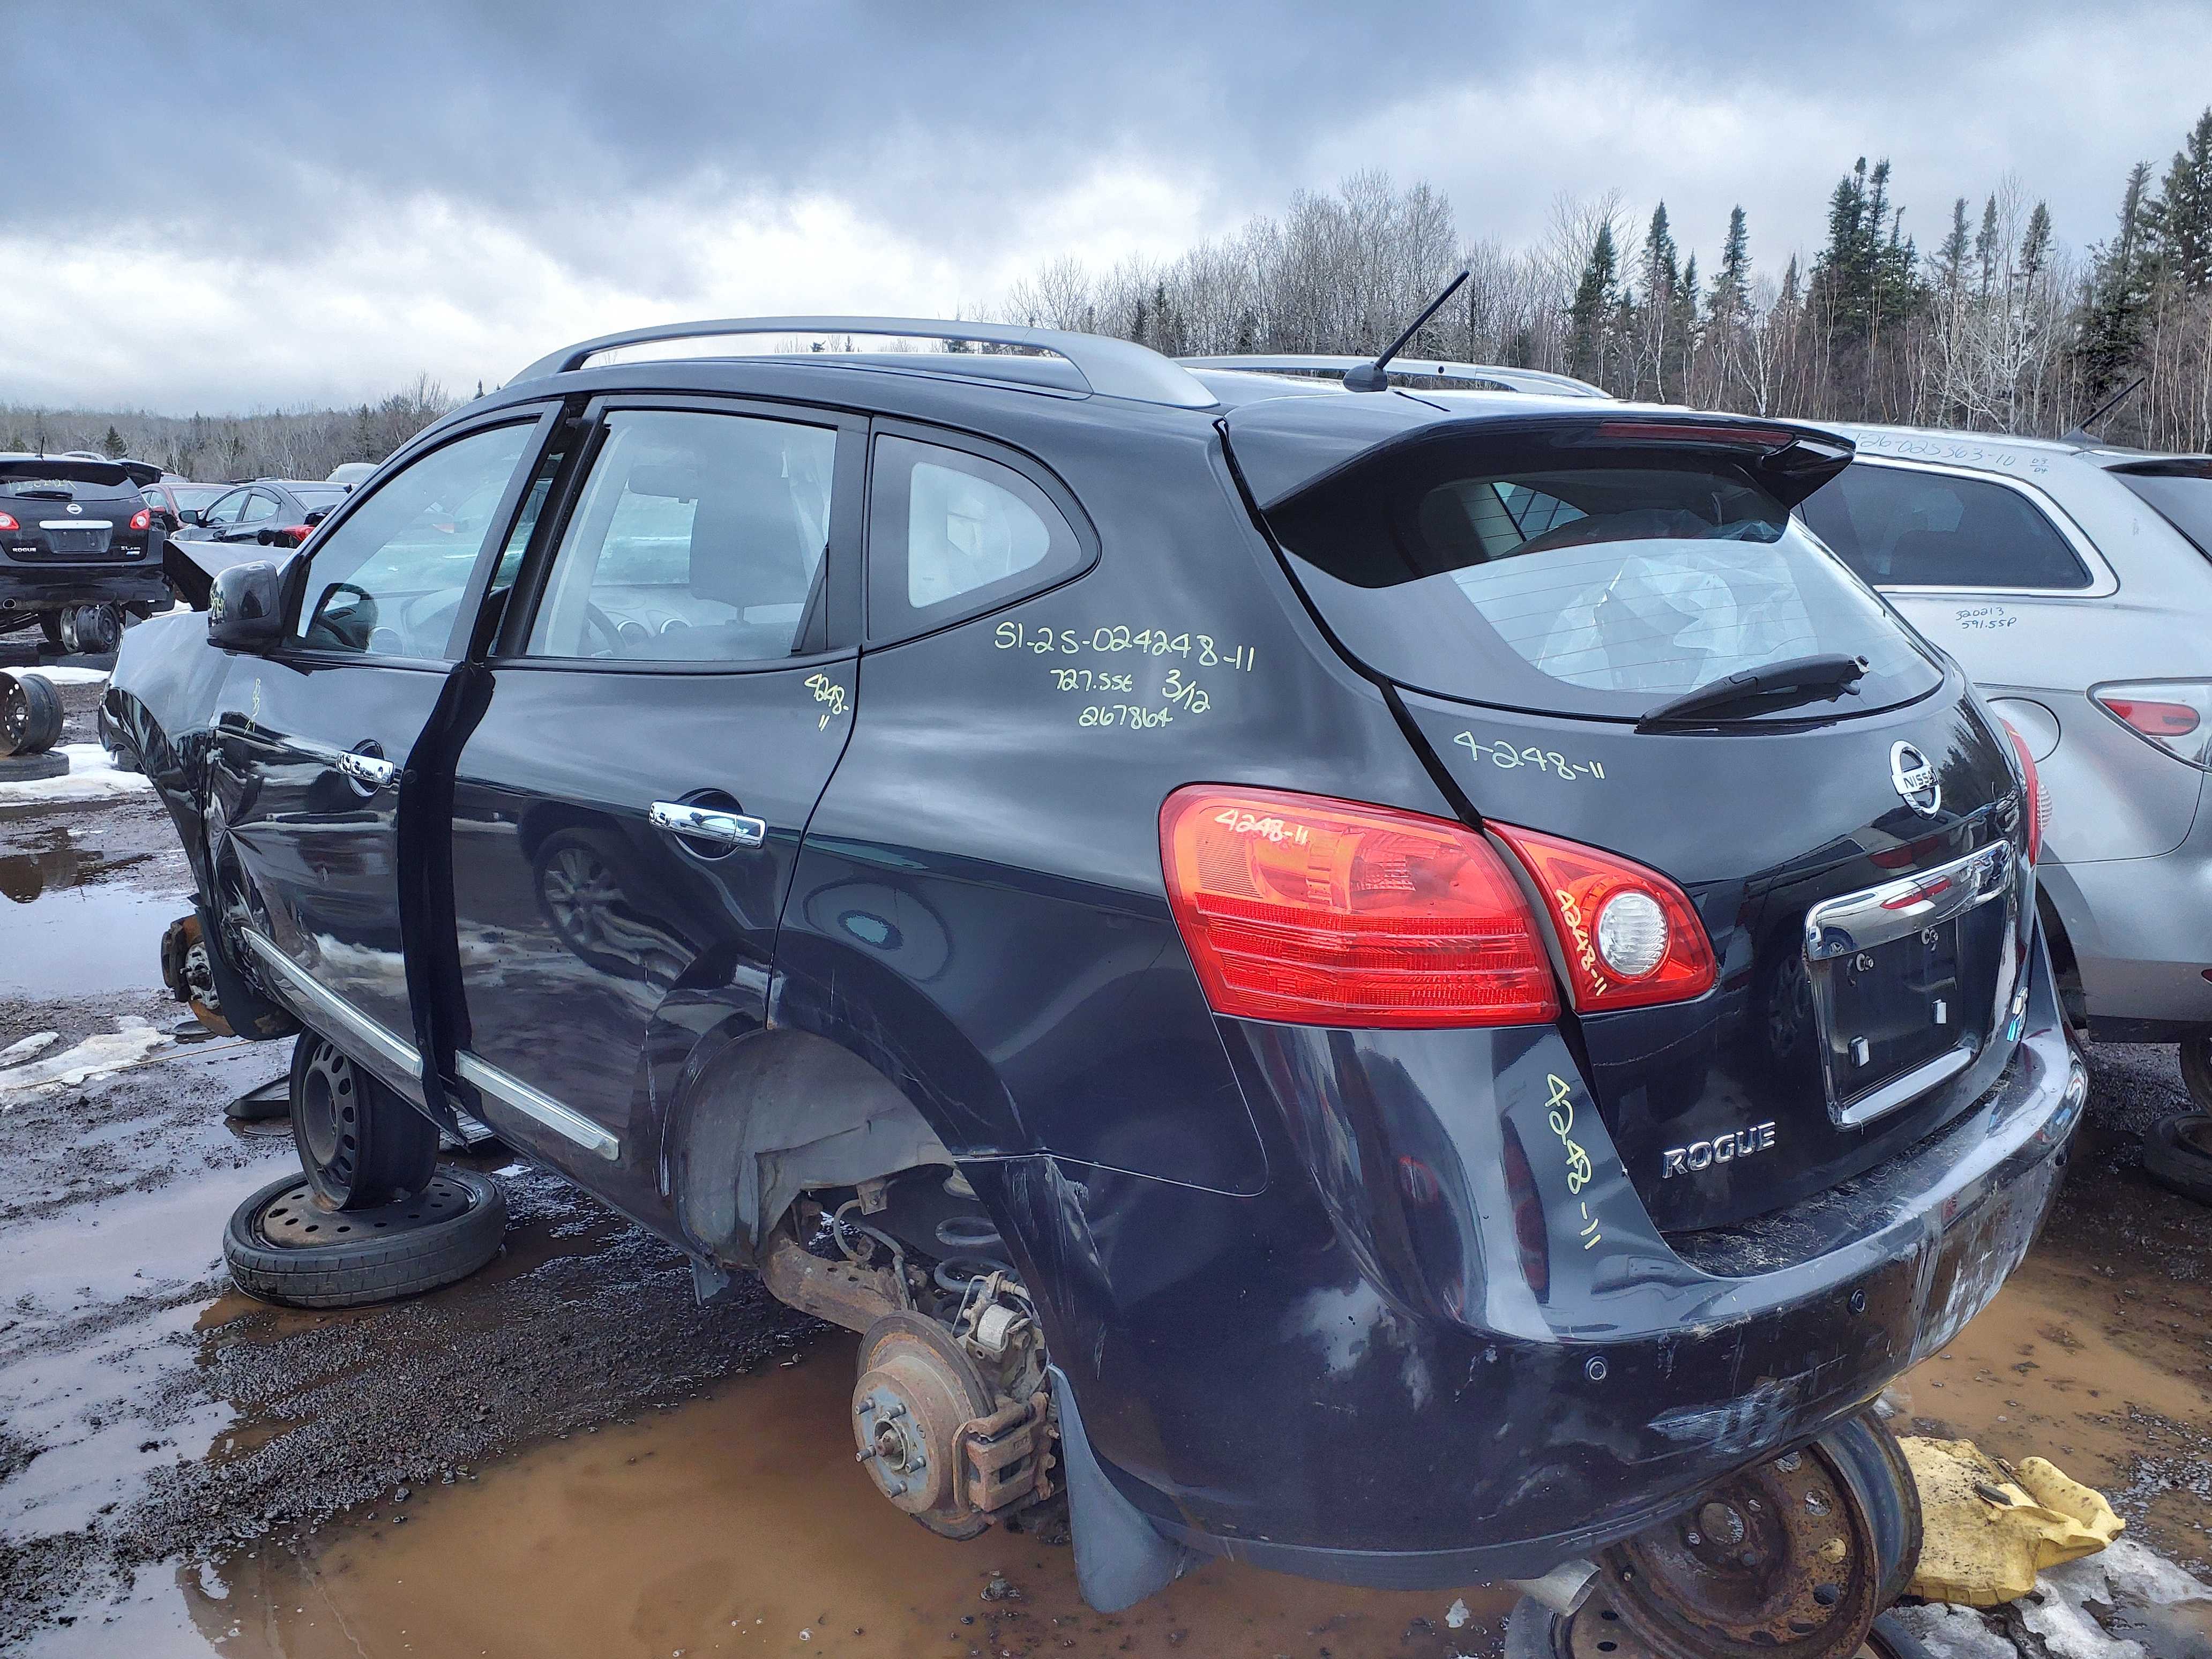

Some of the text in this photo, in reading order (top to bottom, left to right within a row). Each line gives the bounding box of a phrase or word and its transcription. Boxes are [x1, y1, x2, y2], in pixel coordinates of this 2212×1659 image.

[1078, 704, 1174, 730] 267864
[1162, 669, 1211, 714] 3/12
[1453, 730, 1605, 781] 4248-11
[1214, 809, 1309, 846] 4248-11
[1556, 888, 1608, 997] 4248-11
[1544, 1072, 1602, 1250] 4248-11
[1662, 1120, 1776, 1179] ROGUE
